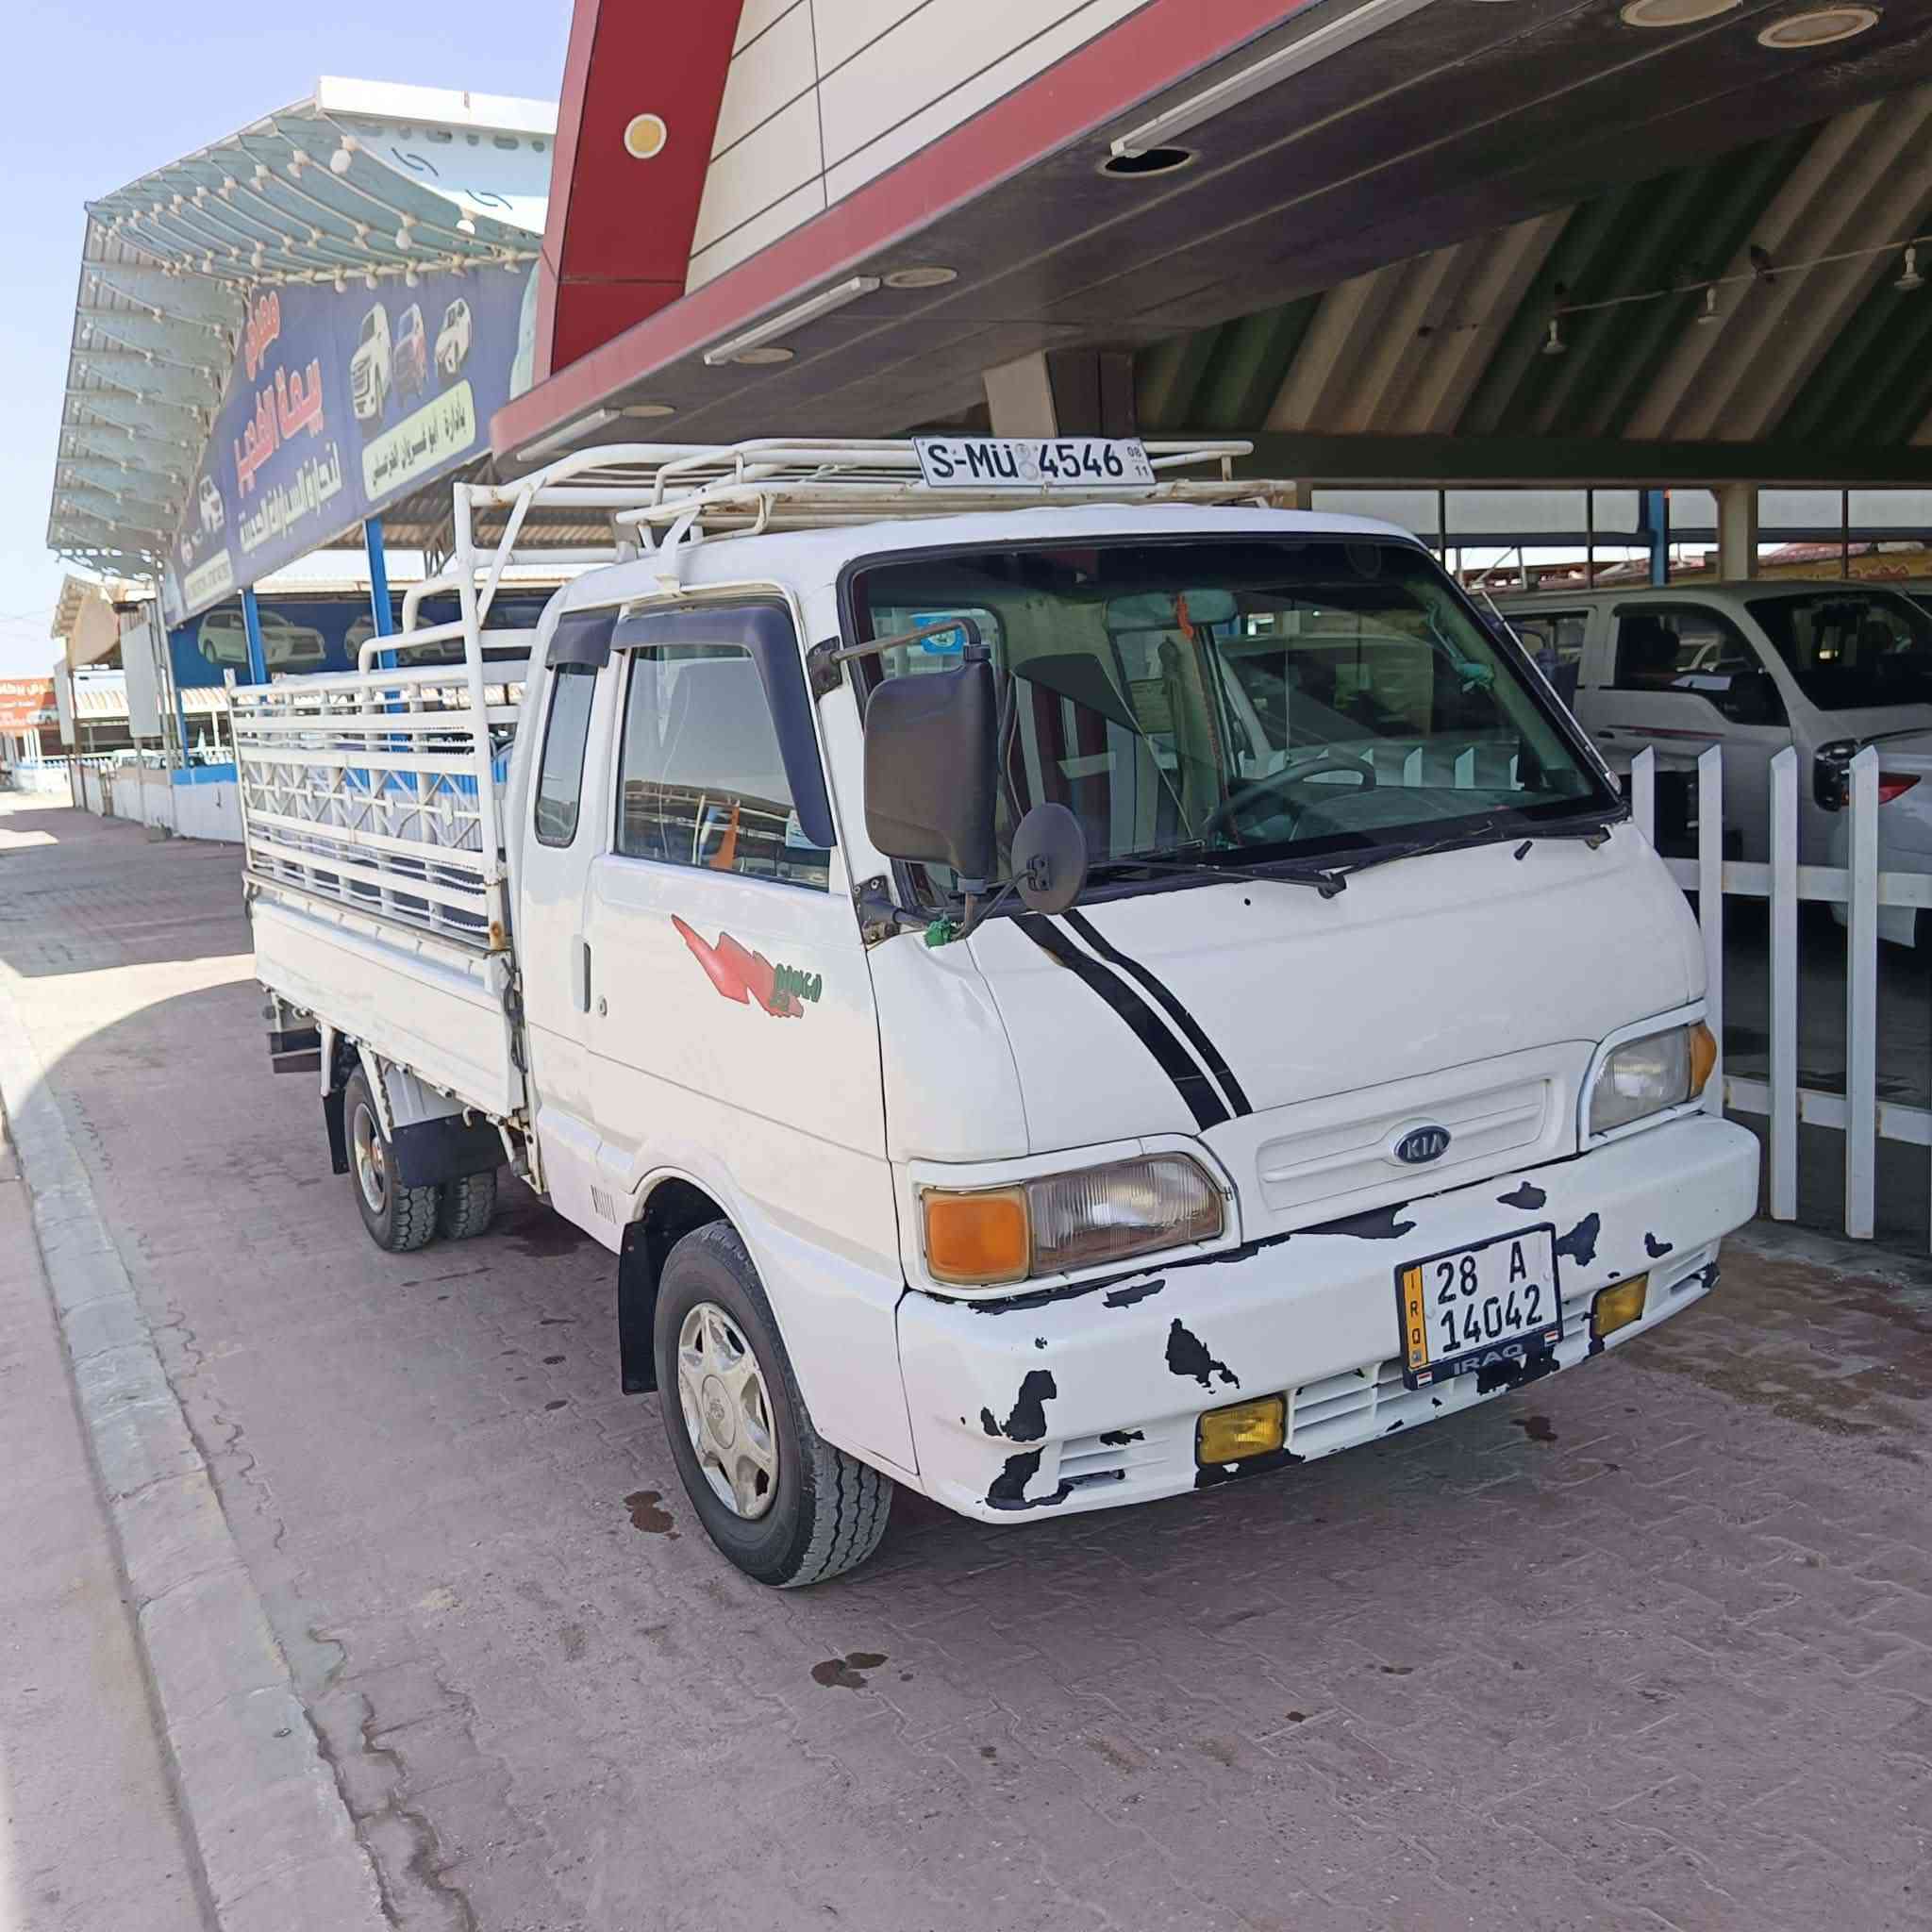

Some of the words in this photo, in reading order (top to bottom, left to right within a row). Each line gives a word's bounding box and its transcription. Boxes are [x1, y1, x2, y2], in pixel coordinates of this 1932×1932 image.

[1039, 443, 1124, 477] 4546
[1407, 1132, 1446, 1159] KIA
[1437, 1256, 1477, 1305] 28
[1509, 1241, 1526, 1283] A
[1441, 1284, 1542, 1353] 14042
[1453, 1343, 1524, 1375] IRAQ
